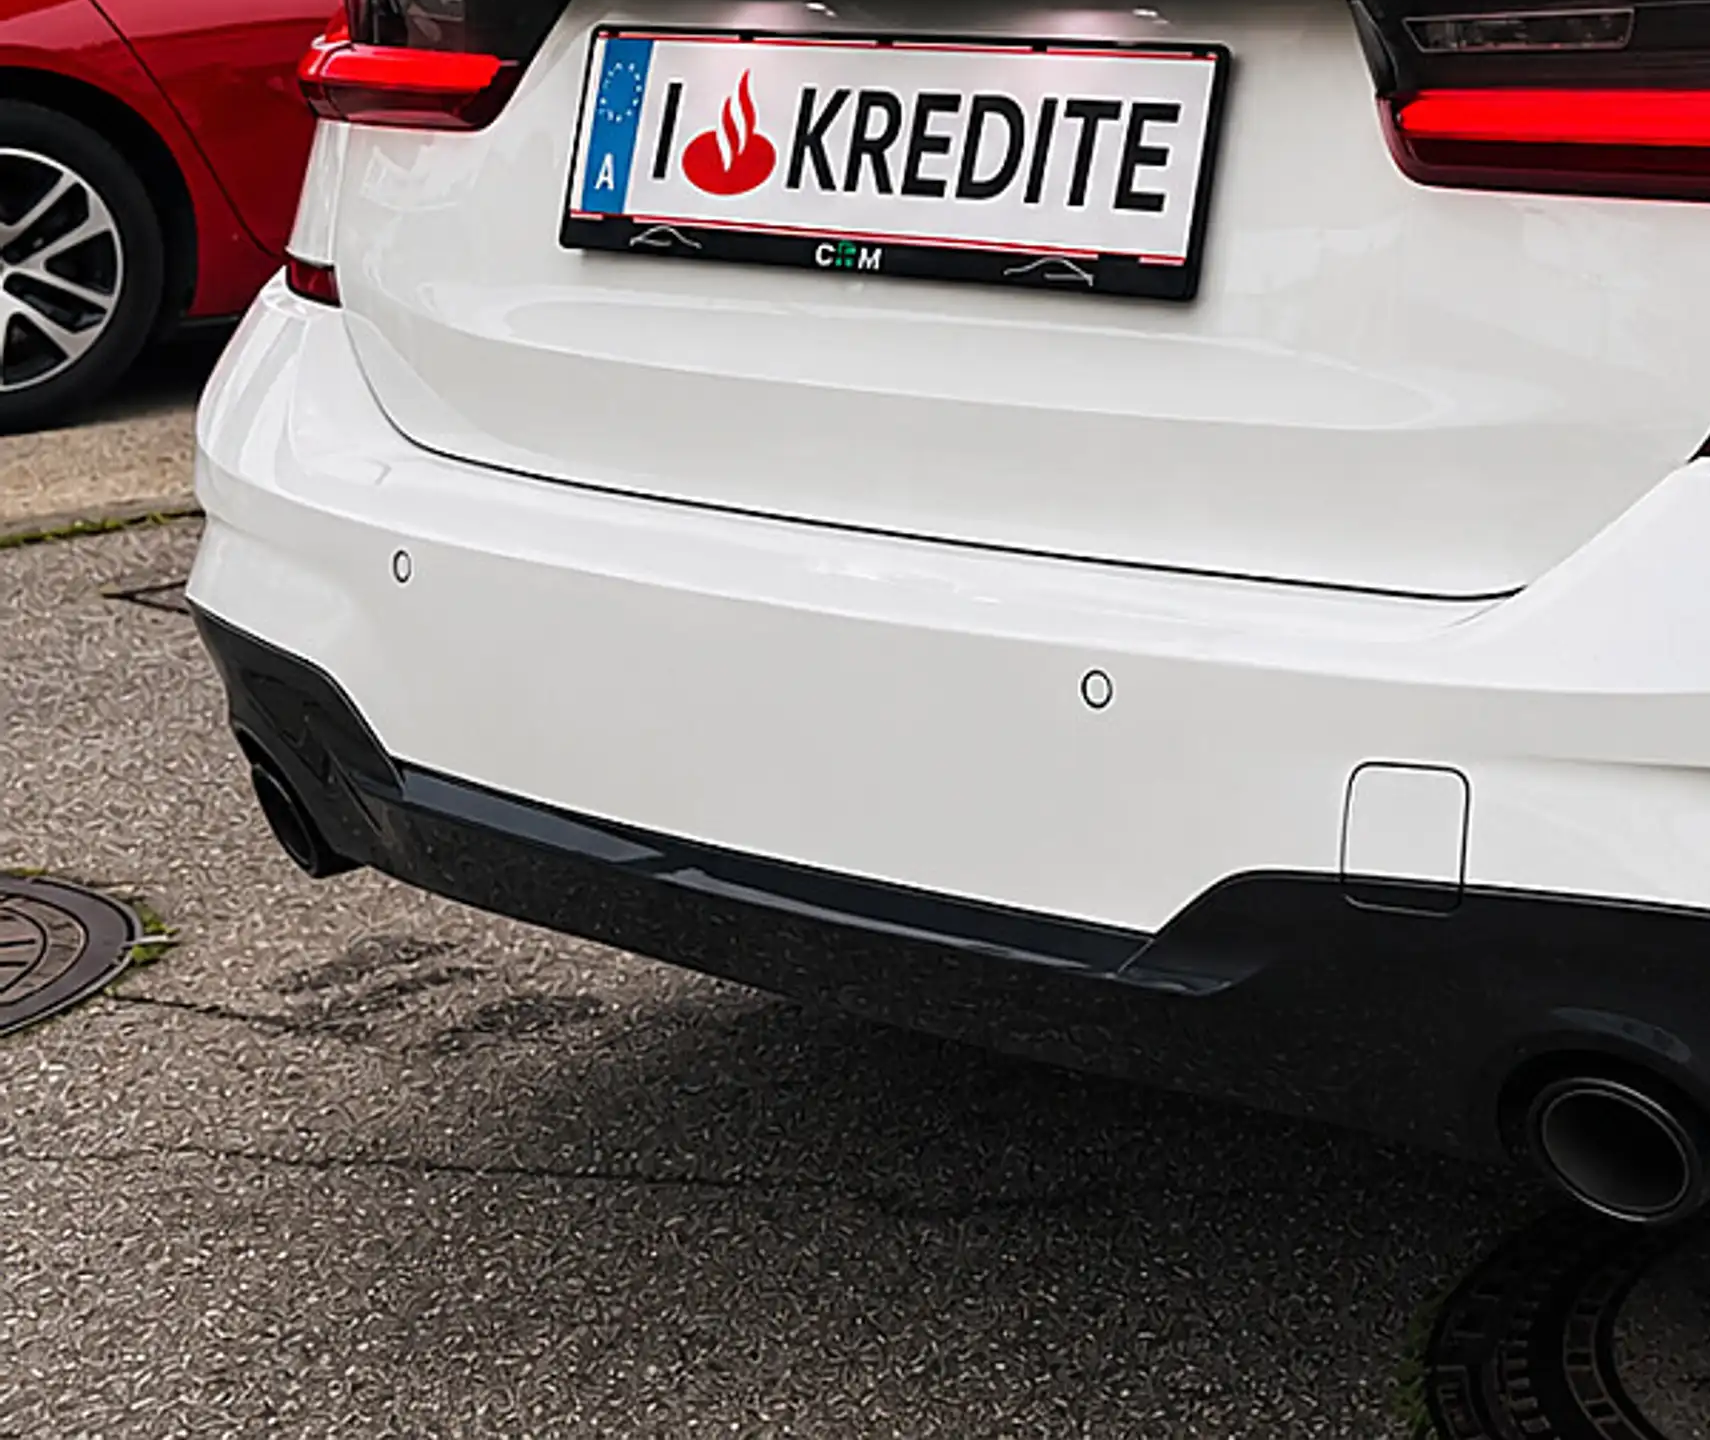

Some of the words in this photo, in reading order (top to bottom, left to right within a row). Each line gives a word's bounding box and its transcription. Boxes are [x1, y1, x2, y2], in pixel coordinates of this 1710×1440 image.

[597, 153, 615, 190] A
[652, 82, 683, 181] I
[785, 87, 1183, 213] KREDITE
